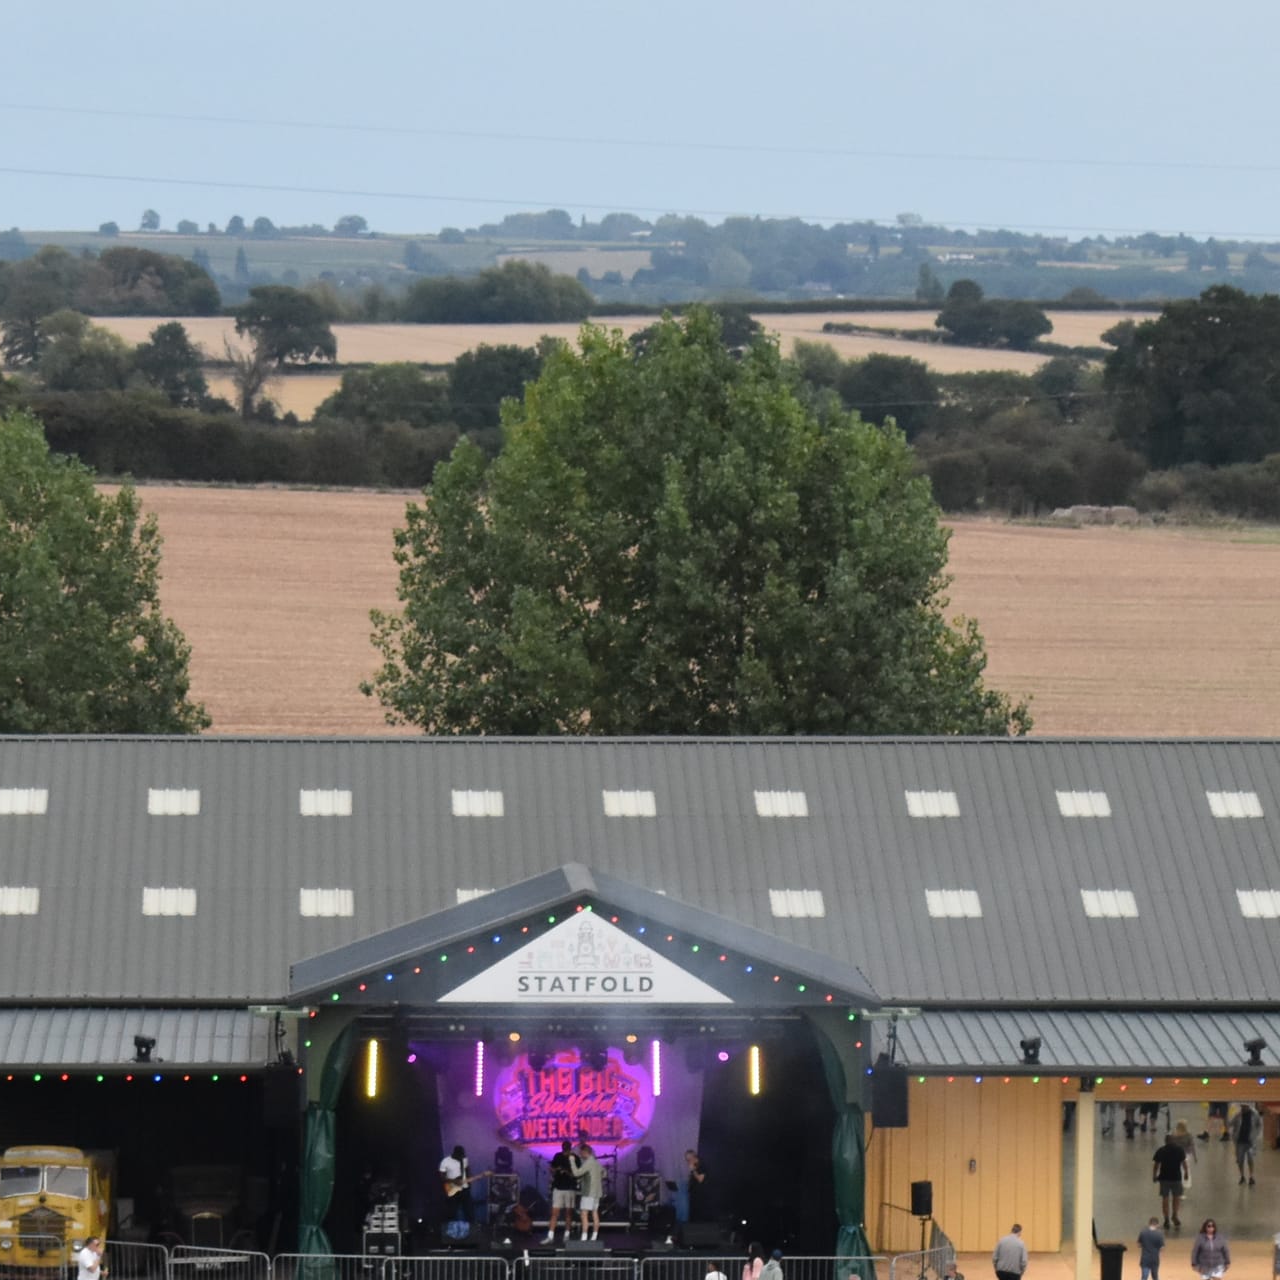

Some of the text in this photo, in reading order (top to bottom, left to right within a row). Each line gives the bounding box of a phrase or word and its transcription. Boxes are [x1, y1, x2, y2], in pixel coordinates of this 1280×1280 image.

[517, 975, 654, 993] STATFOLD
[524, 1067, 618, 1095] THE BIG
[528, 1090, 618, 1121] Statfold
[521, 1116, 624, 1140] WEEKENDER
